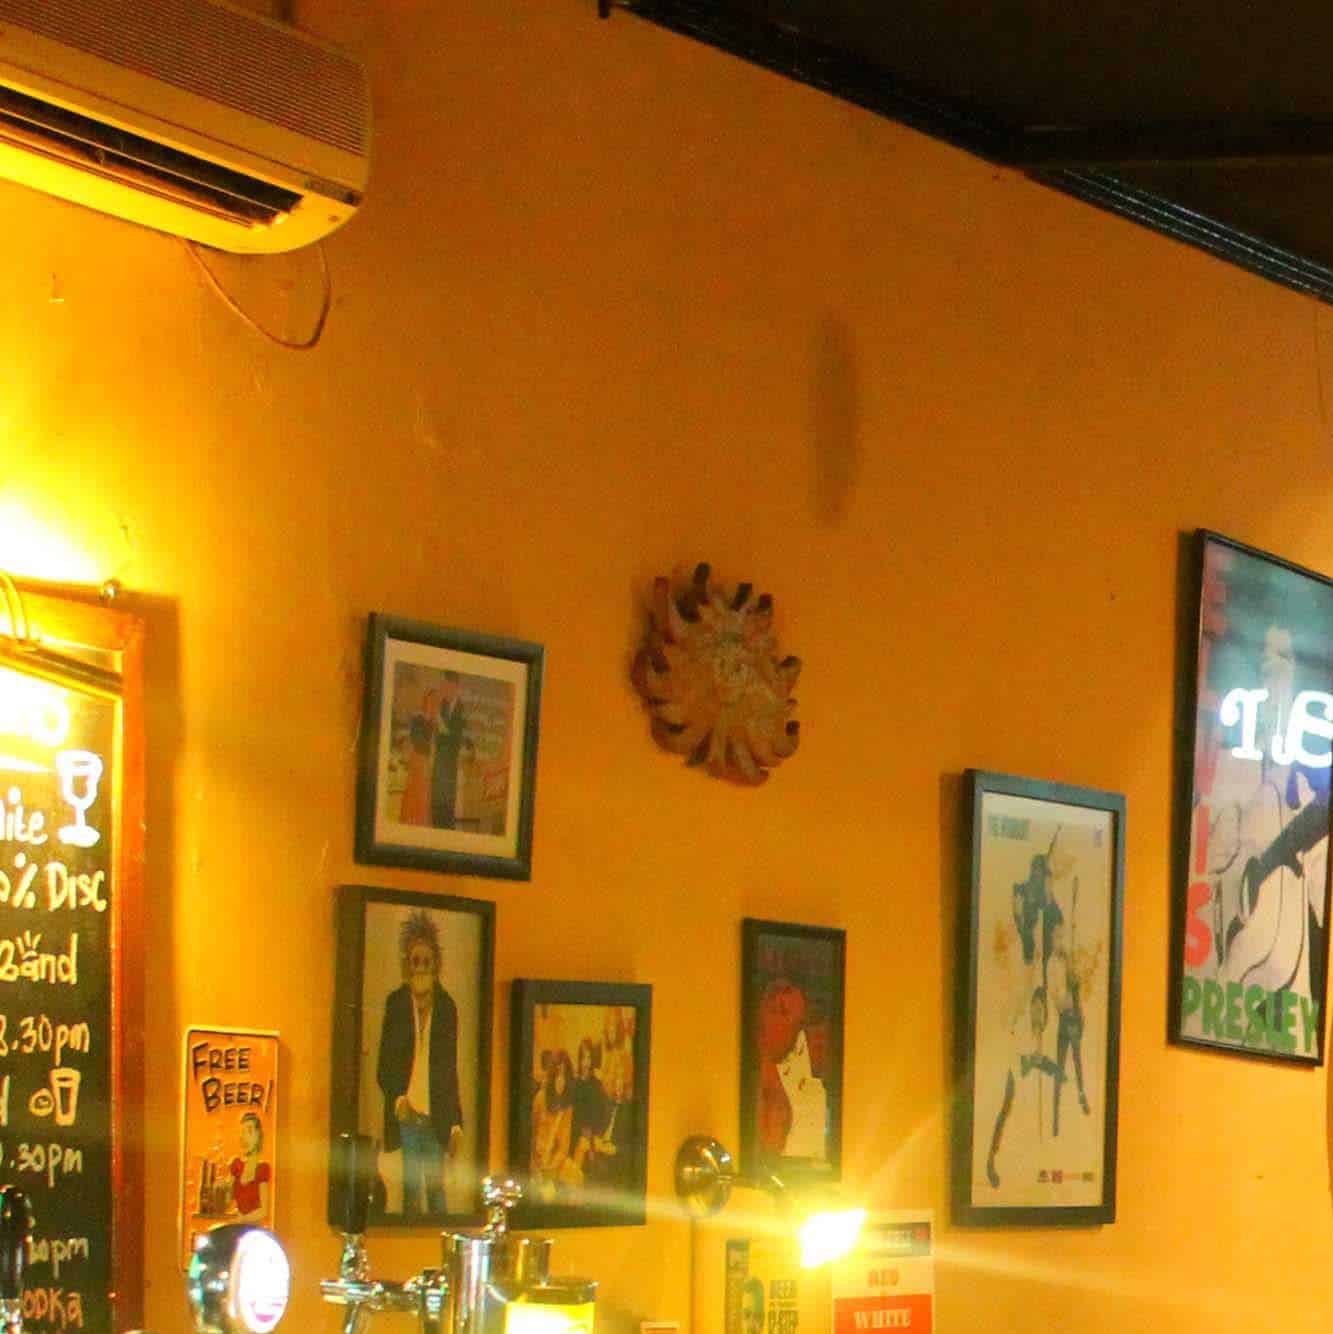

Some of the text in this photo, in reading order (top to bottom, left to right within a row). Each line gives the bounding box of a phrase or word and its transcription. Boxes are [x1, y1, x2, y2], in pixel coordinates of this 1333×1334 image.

[1181, 975, 1319, 1053] PRESLEY
[192, 1042, 251, 1081] FREE
[202, 1077, 274, 1113] BEER!
[853, 1309, 911, 1328] WHITE
